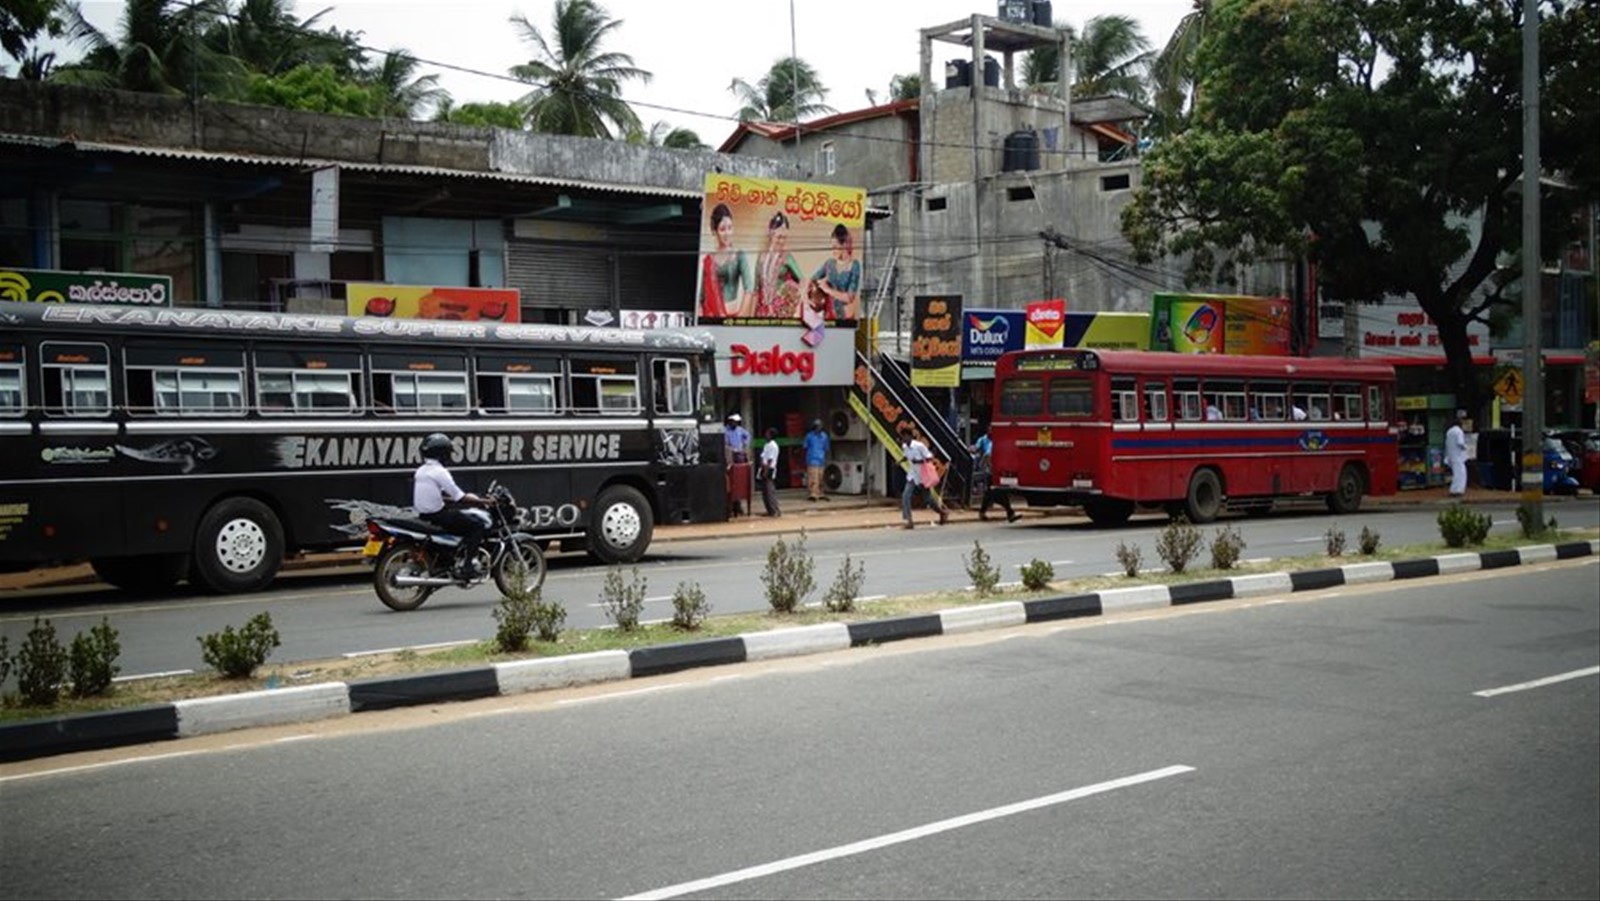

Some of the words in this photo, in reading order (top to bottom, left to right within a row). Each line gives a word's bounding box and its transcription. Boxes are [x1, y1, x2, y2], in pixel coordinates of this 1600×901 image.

[42, 305, 344, 333] EKANAYAKE
[353, 319, 486, 338] SUPER
[495, 325, 645, 343] SERVICE
[970, 328, 1004, 345] Dulux
[730, 343, 814, 382] Dialog
[281, 436, 424, 467] EKANAYAK
[450, 435, 525, 463] SUPER
[532, 434, 621, 461] SERVICE
[514, 504, 580, 528] RBO
